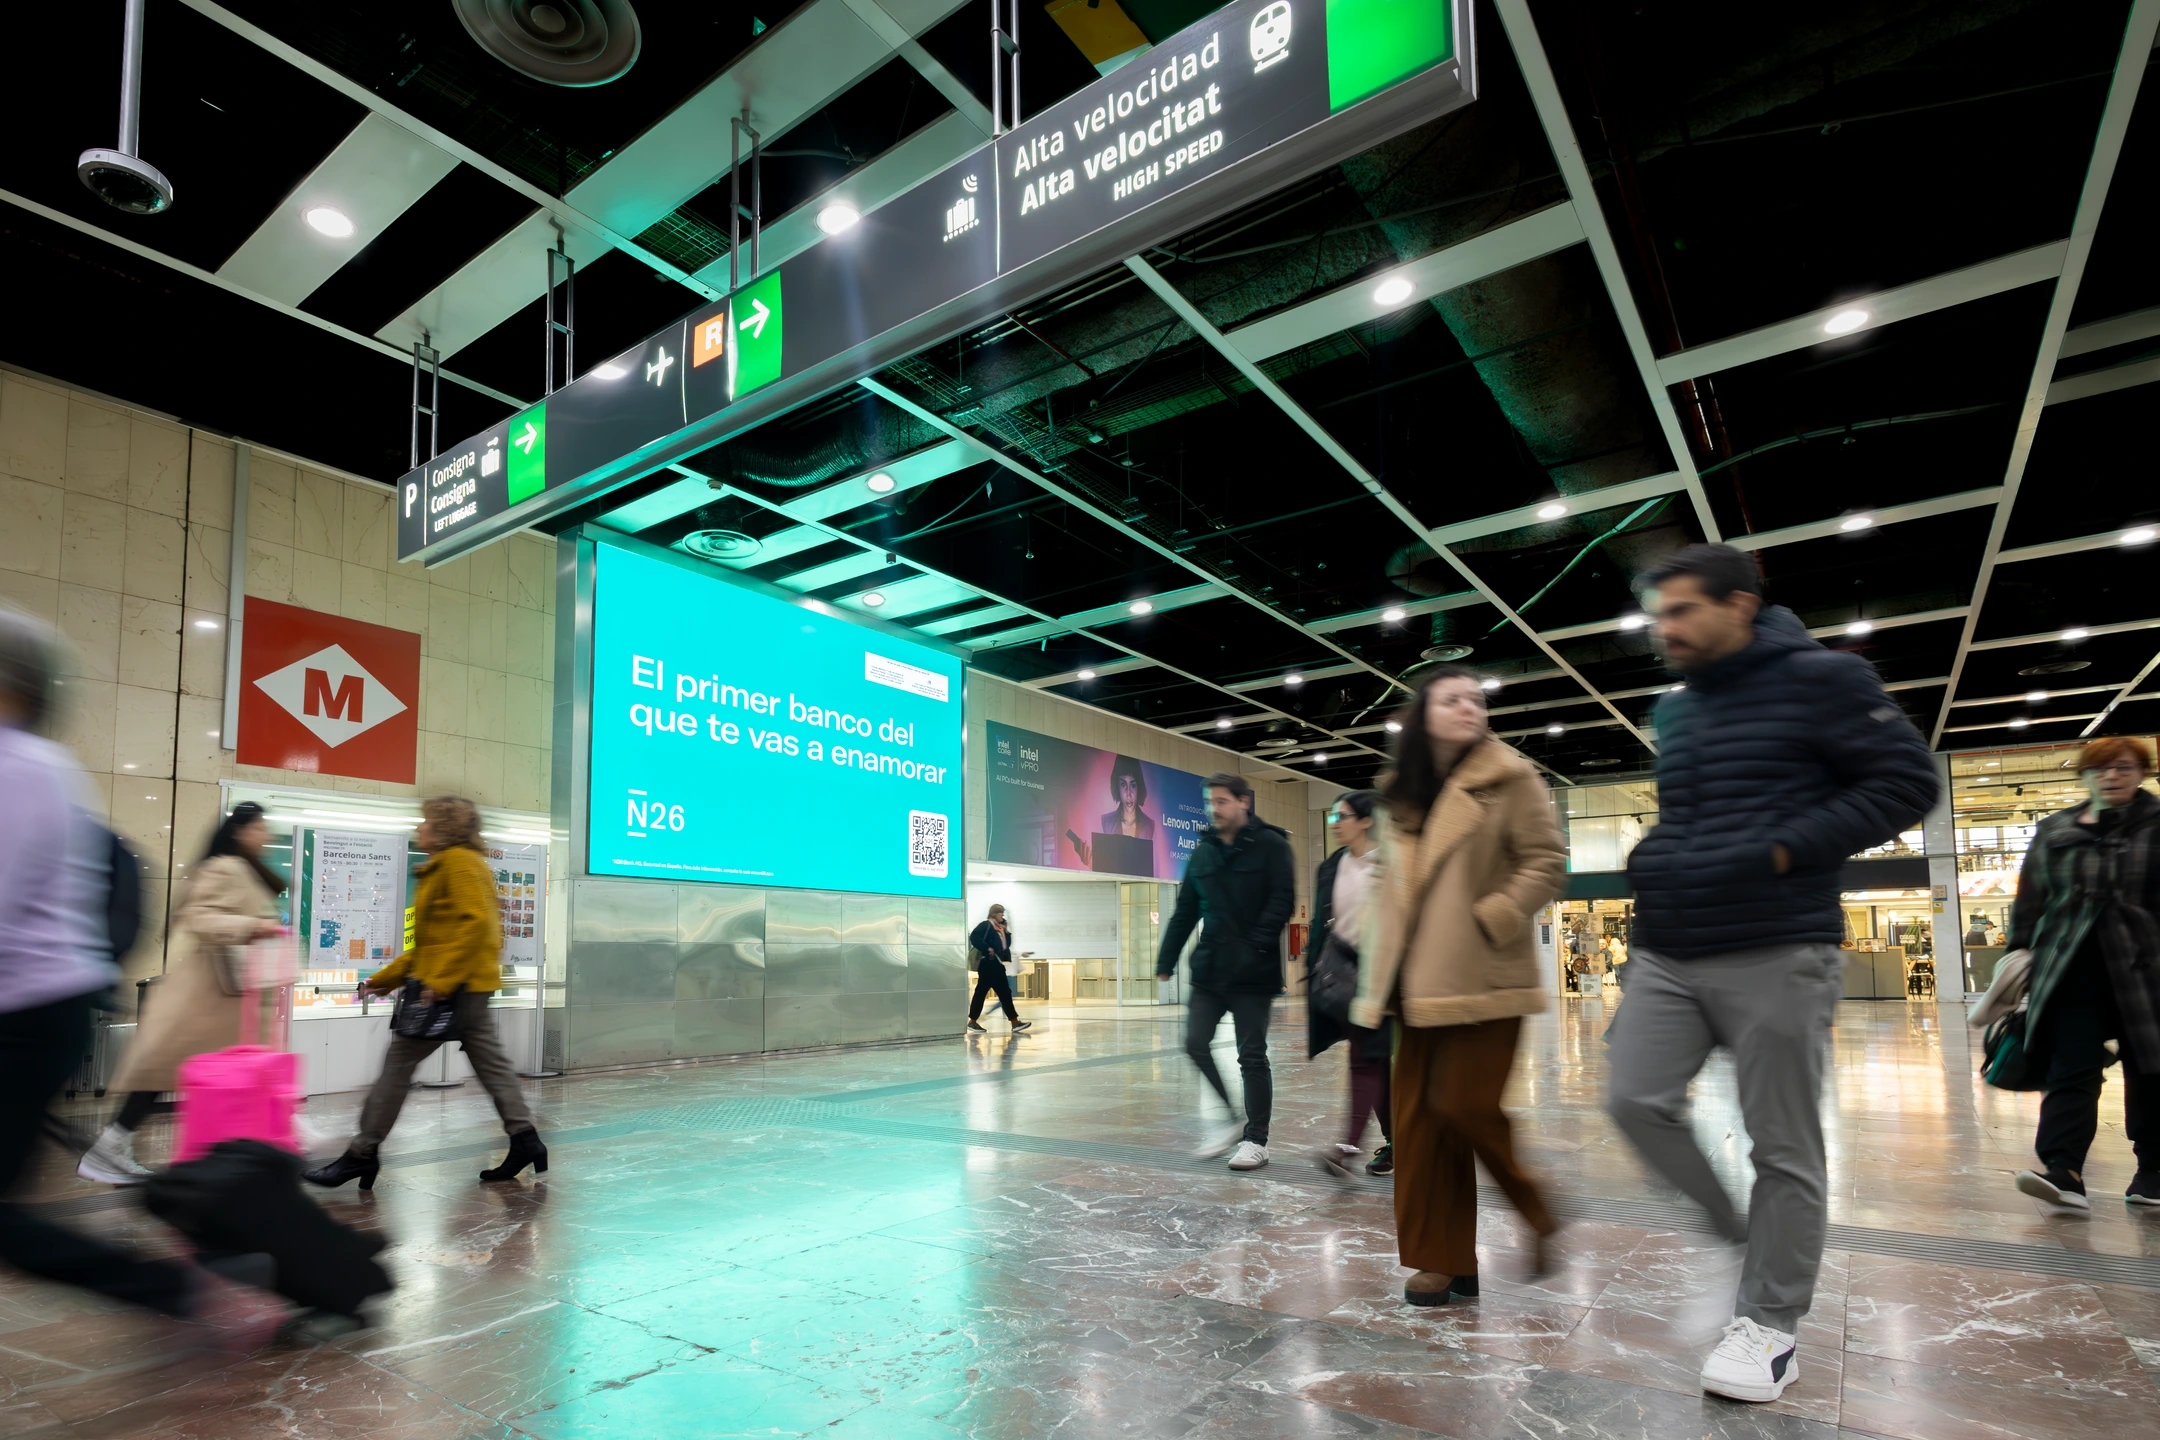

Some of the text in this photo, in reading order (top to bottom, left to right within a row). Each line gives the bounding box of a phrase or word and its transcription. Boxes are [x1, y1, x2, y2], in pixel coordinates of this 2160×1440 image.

[1014, 31, 1221, 178] Alta velocidad
[1020, 82, 1222, 216] Alta velocitat
[1113, 130, 1224, 202] HIGH SPEED
[706, 320, 722, 351] R
[432, 451, 475, 487] Consigna
[405, 482, 417, 518] P
[431, 478, 476, 514] Consigna
[434, 501, 477, 532] LEFT LUGGAGE
[303, 668, 364, 723] M
[633, 655, 914, 747] El primer banco del
[629, 704, 947, 785] que te vas a enamorar
[997, 739, 1009, 749] intel
[1020, 745, 1039, 761] intel
[1001, 775, 1011, 783] PCs
[1010, 777, 1020, 786] built
[1027, 781, 1045, 790] business
[1020, 761, 1039, 772] vPRO
[628, 797, 685, 832] N26
[1162, 813, 1190, 831] Lenovo
[323, 850, 392, 861] Barcelona Sants
[1177, 835, 1195, 849] Aura
